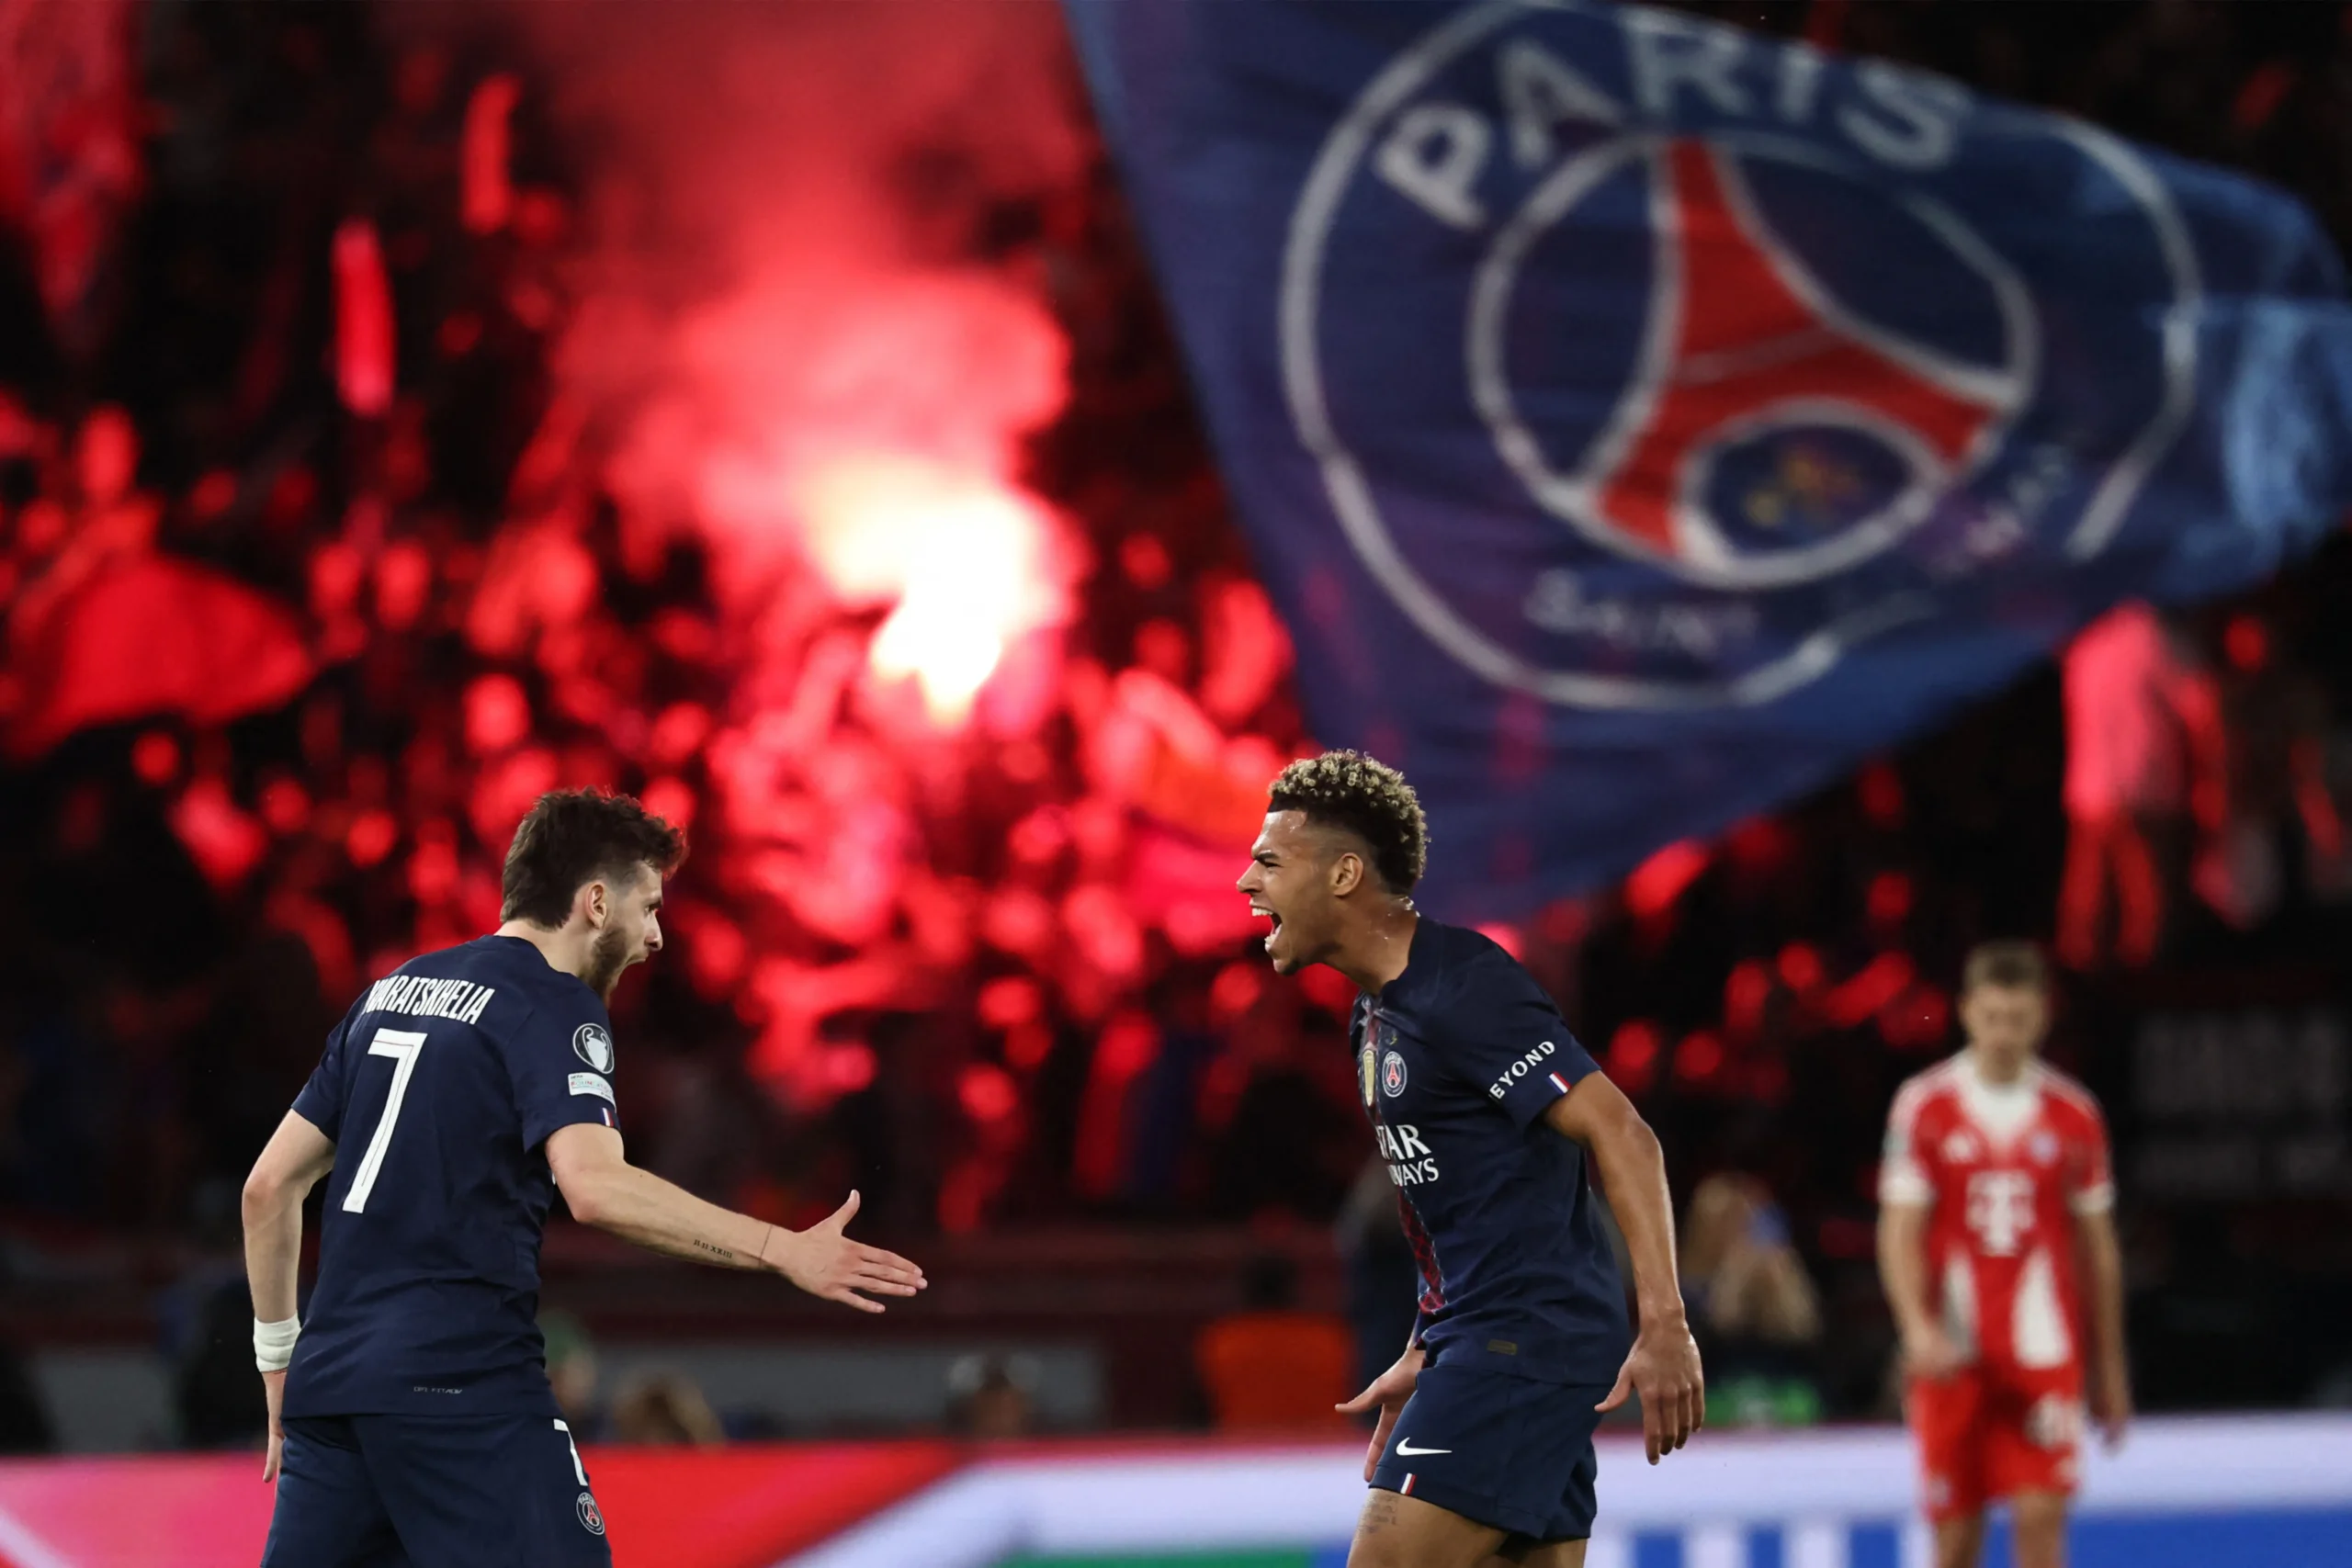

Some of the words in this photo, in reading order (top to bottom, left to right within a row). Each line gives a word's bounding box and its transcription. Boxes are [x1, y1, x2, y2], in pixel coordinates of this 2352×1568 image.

[1375, 6, 1973, 228] PARIS
[1488, 1041, 1555, 1101] EYOND
[342, 1027, 428, 1213] 7
[1375, 1123, 1432, 1160] TAR
[553, 1418, 589, 1486] 7
